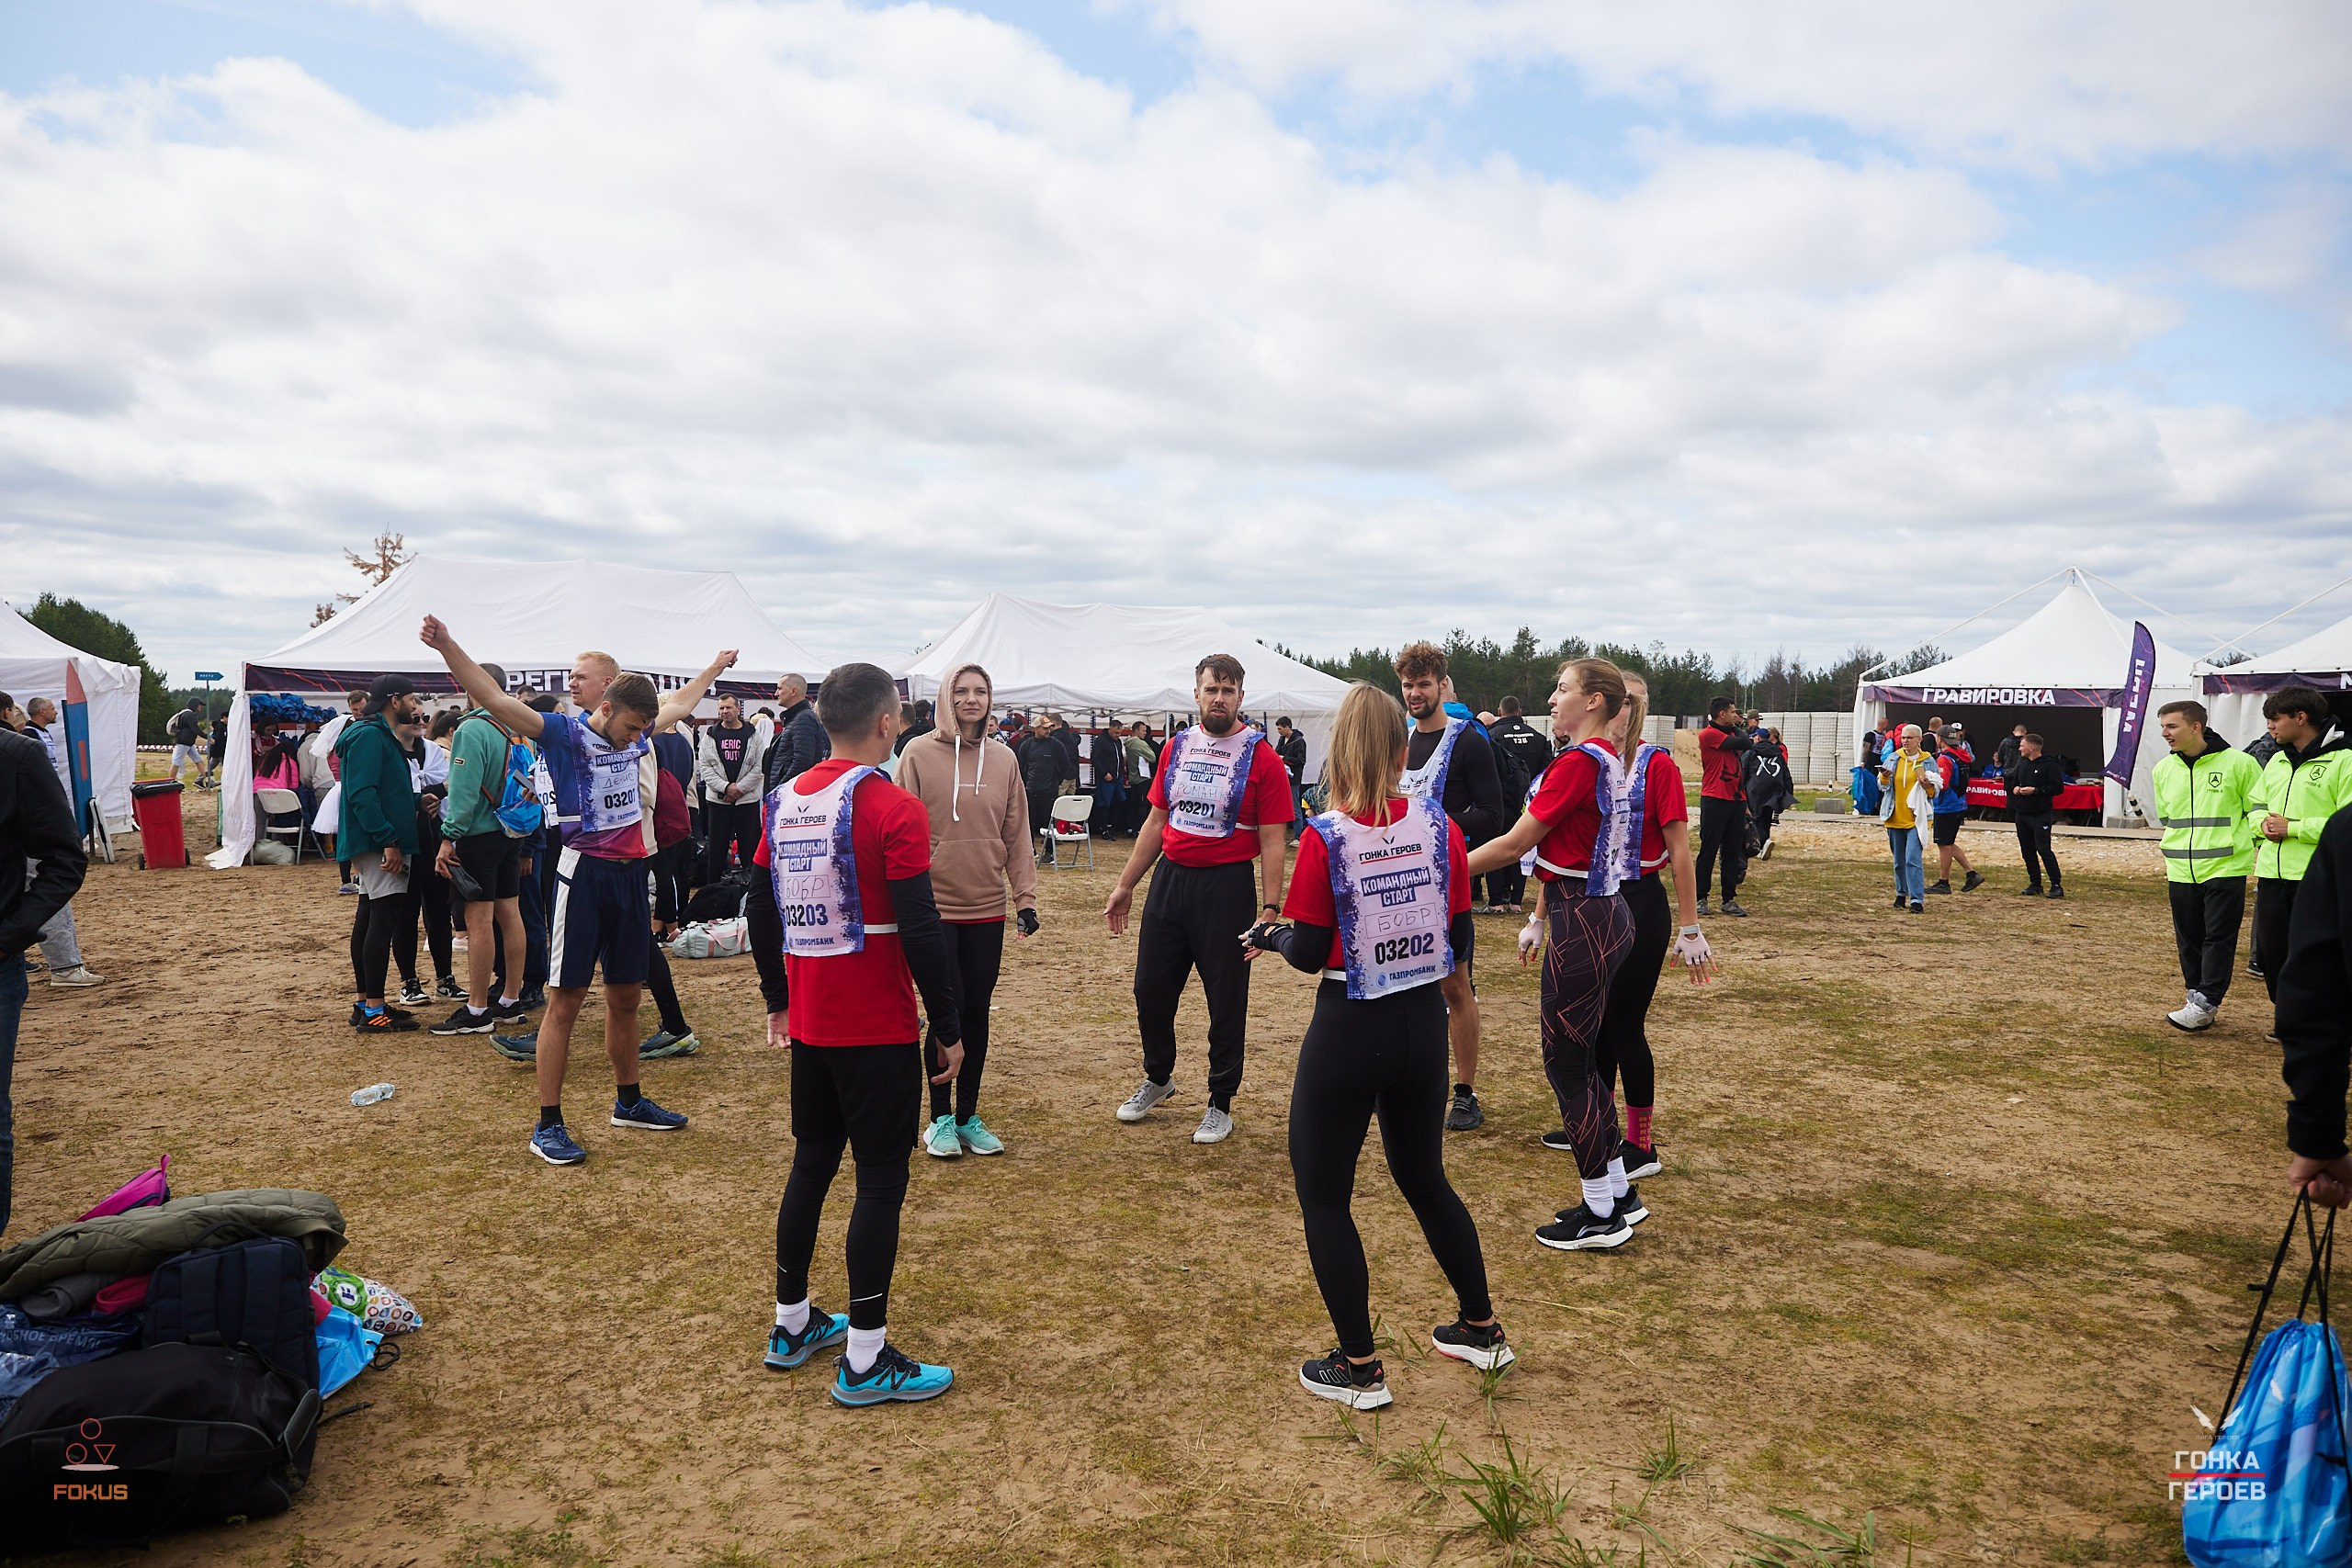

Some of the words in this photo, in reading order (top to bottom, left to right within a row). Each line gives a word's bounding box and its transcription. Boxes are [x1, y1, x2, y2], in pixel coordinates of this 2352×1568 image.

[1921, 688, 2056, 705] ГРАВИРОВКА
[1207, 749, 1231, 758] ГЕРОЕВ
[1182, 761, 1229, 776] КОМАНДНЫЙ
[1191, 772, 1213, 783] СТАРТ
[1178, 799, 1216, 818] 03201
[779, 818, 798, 826] ГОНКА
[800, 815, 827, 825] ГЕРОЕВ
[1183, 819, 1216, 830] ГАЗПРОМБАНК
[778, 838, 827, 858] КОМАНДНЫЙ
[1359, 849, 1389, 862] ГОНКА
[1390, 843, 1422, 857] ГЕРОЕВ
[789, 857, 811, 872] СТАРТ
[1362, 866, 1430, 895] КОМАНДНЫЙ
[1382, 887, 1415, 906] СТАРТ
[786, 903, 829, 927] 03203
[1378, 908, 1431, 932] БОБР
[795, 937, 835, 946] ГАЗПРОМБАНК
[1374, 931, 1434, 965] 03202
[1388, 964, 1437, 981] ГАЗПРОМБАНК
